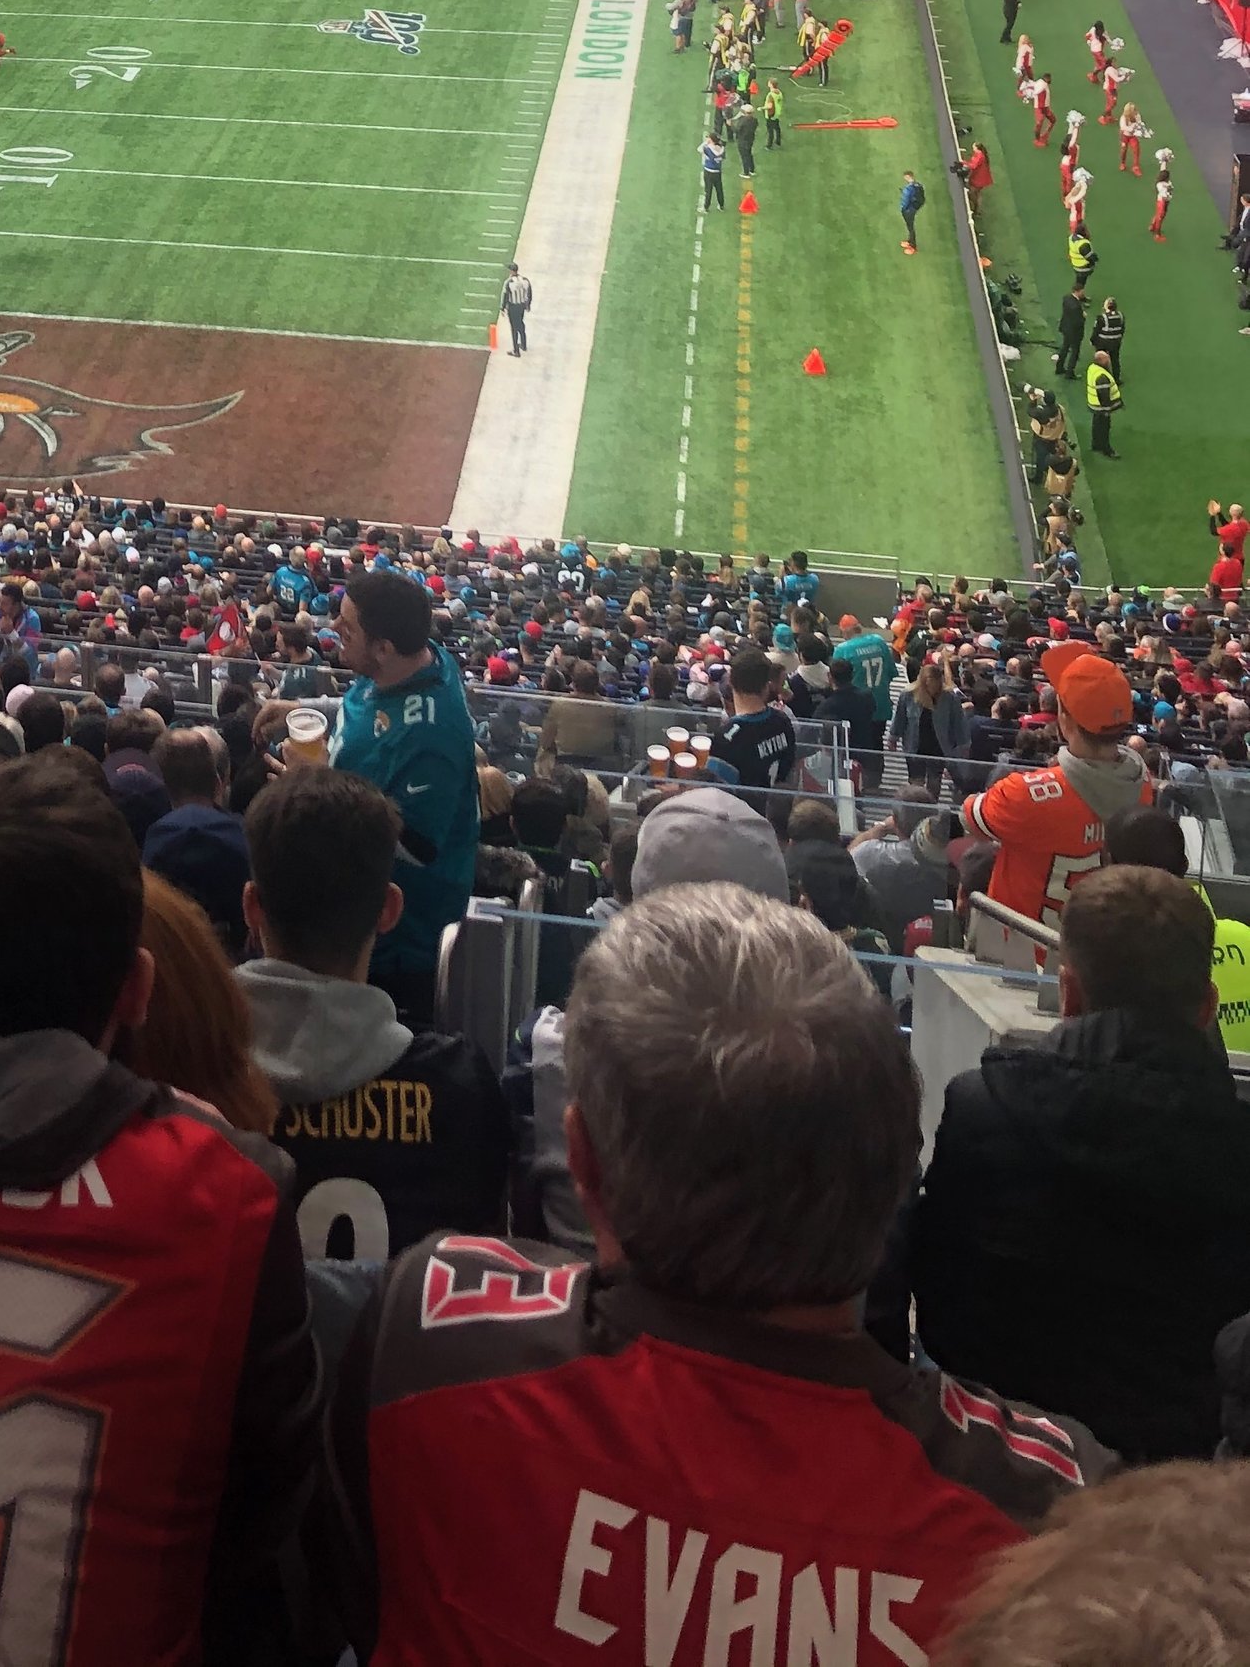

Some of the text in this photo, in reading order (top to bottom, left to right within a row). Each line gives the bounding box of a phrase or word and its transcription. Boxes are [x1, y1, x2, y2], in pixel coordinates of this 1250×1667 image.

[68, 45, 153, 83] 20
[861, 656, 884, 689] 17
[402, 693, 437, 726] 21
[757, 732, 789, 760] NEWTON
[554, 1488, 931, 1667] EVANS
